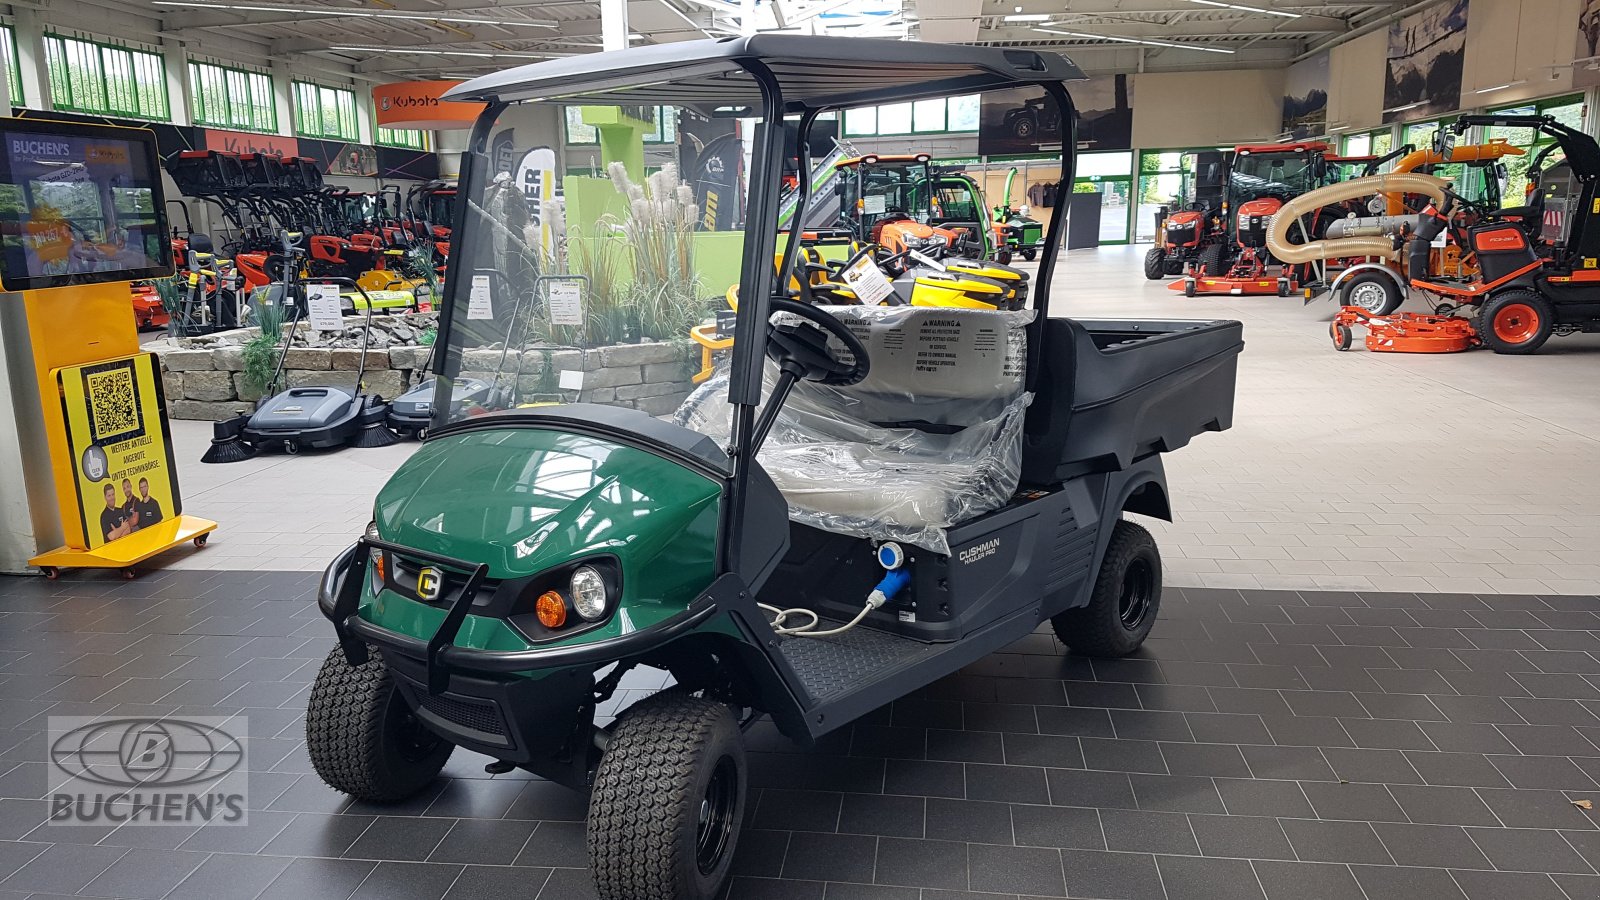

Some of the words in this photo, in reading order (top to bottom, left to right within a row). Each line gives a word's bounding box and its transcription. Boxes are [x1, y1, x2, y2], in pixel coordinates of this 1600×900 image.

[393, 95, 439, 107] Kubota
[13, 140, 70, 156] BUCHEN'S
[111, 440, 131, 454] WEITERE
[131, 435, 153, 448] AKTUELLE
[123, 451, 146, 464] ANGEBOTE
[111, 470, 127, 482] UNTER
[959, 537, 1000, 561] CUSHMAN
[964, 552, 985, 565] HAULER
[985, 547, 996, 557] PRO
